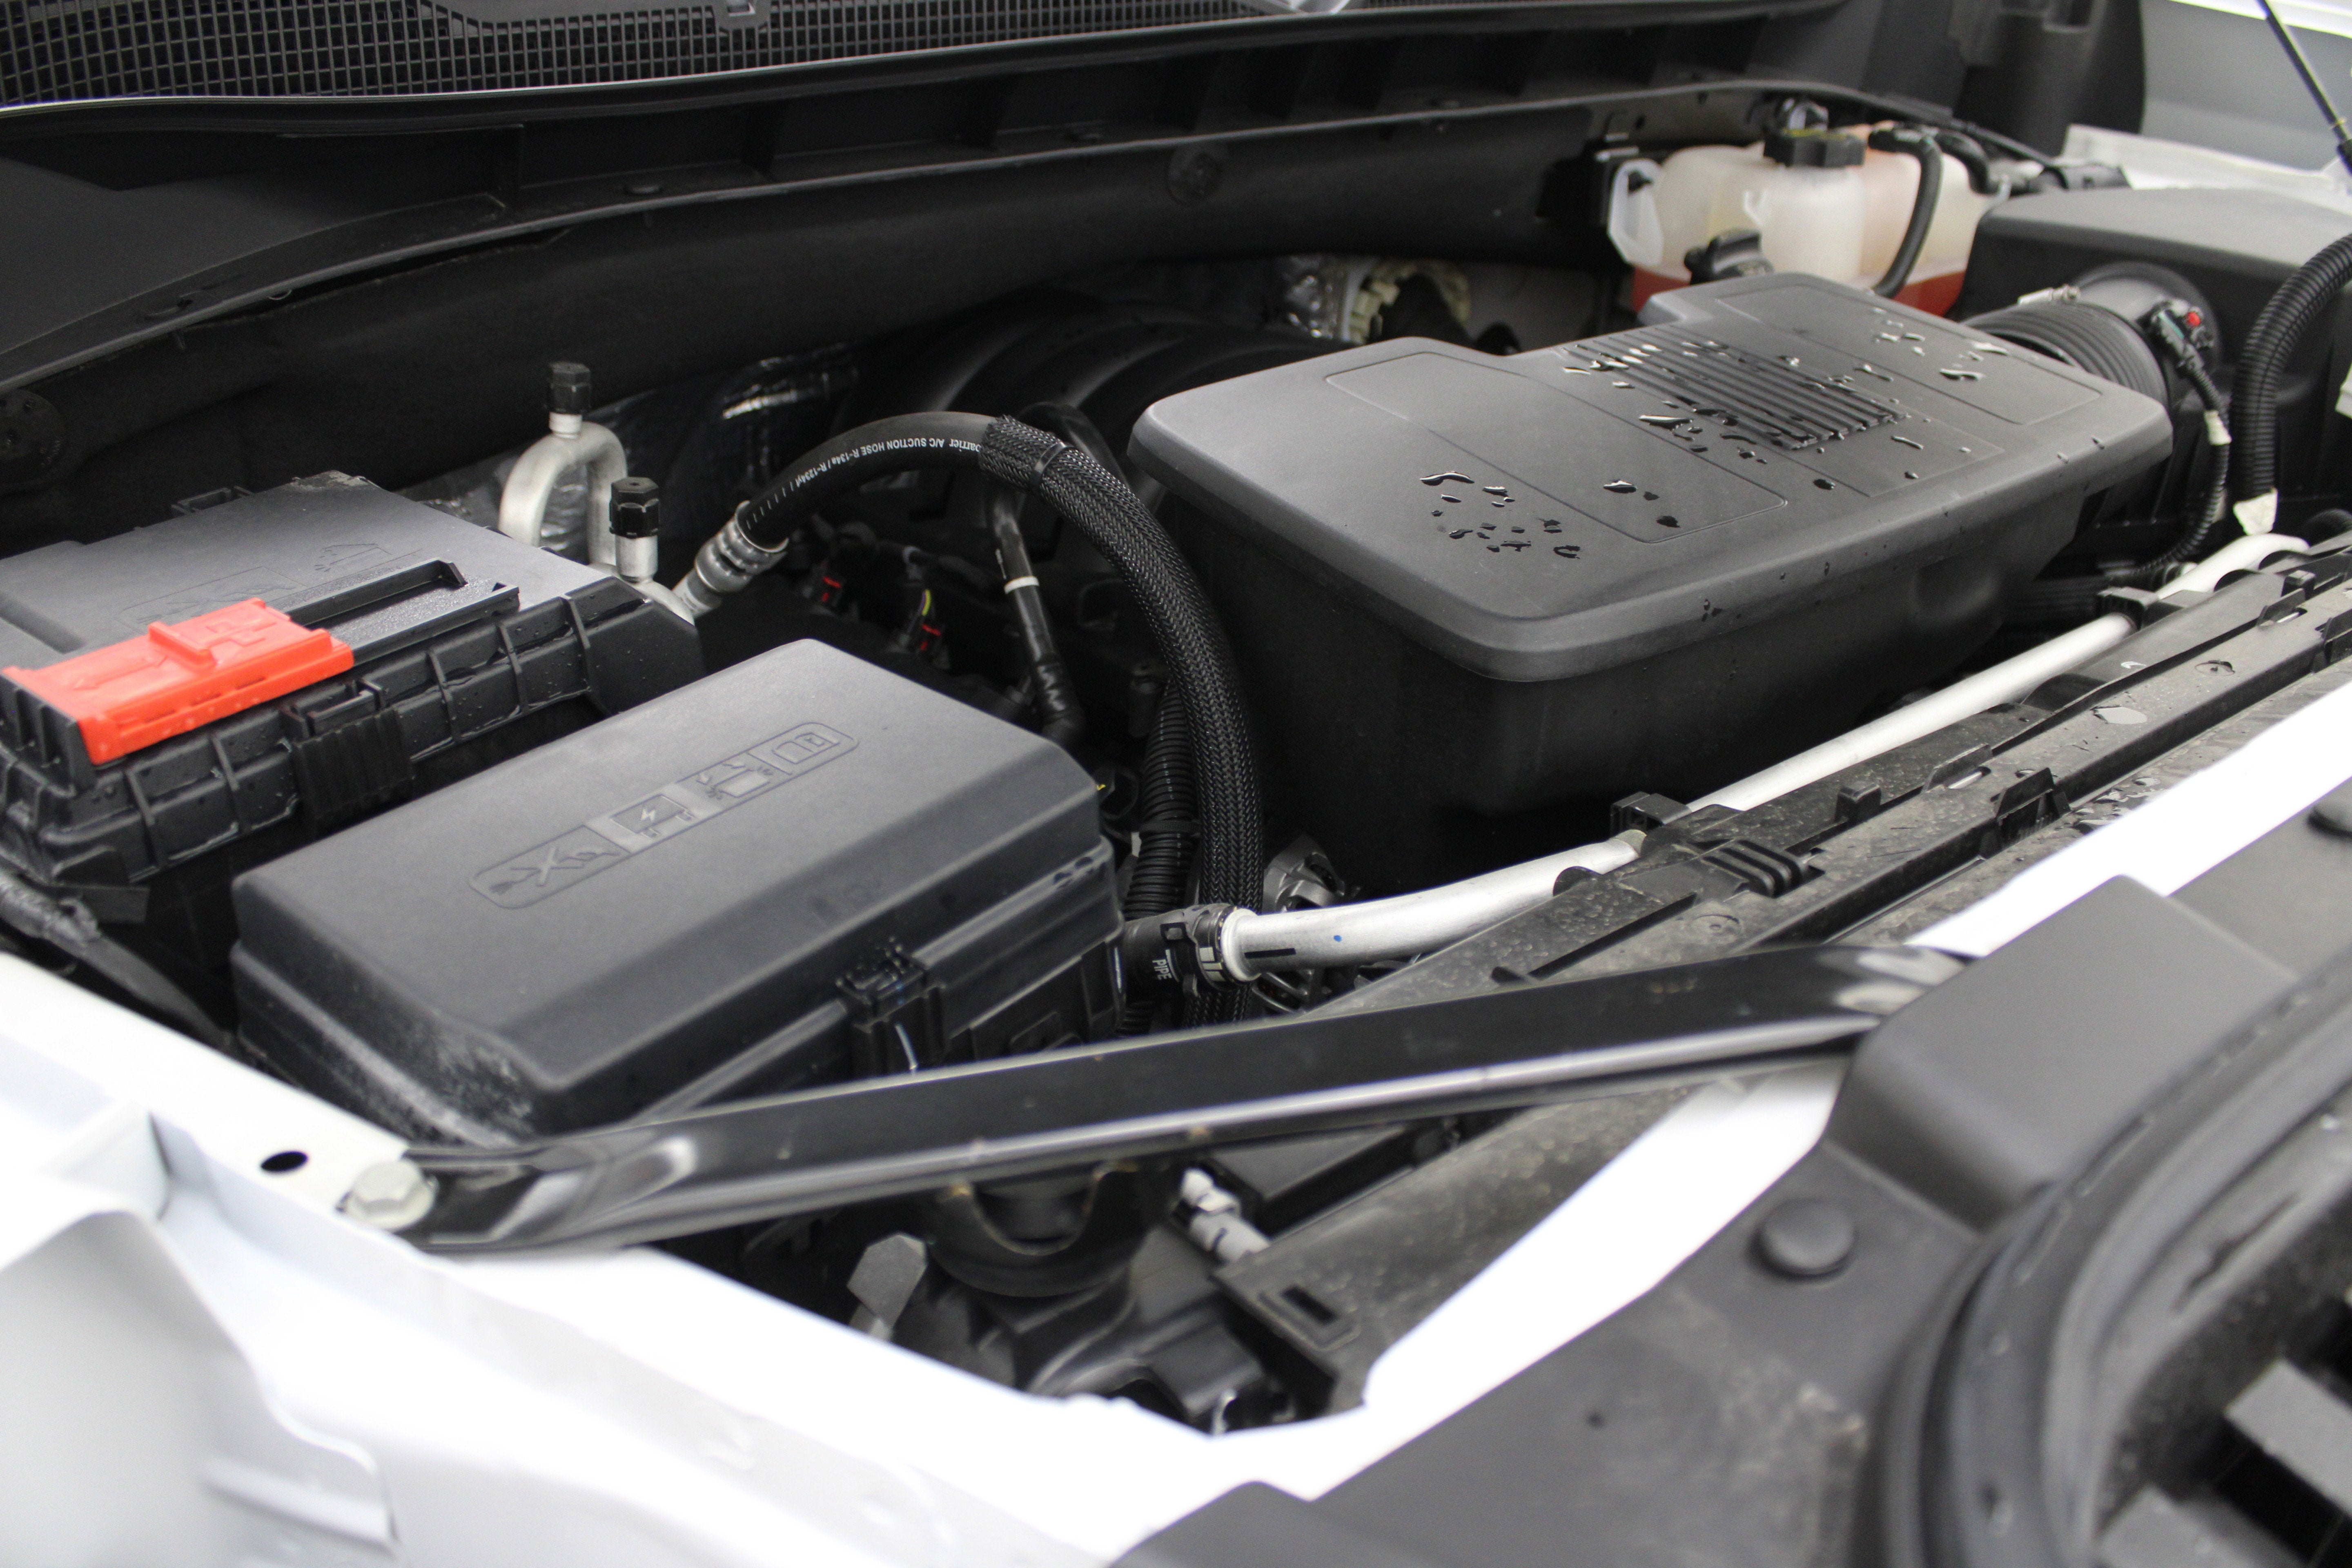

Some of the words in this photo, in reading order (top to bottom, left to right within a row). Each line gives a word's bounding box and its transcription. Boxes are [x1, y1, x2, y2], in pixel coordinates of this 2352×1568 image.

[860, 442, 885, 456] HOSE
[886, 437, 927, 450] SUCTION
[929, 437, 945, 448] A/C
[831, 448, 860, 465] R-134a
[1152, 959, 1172, 980] PIPE
